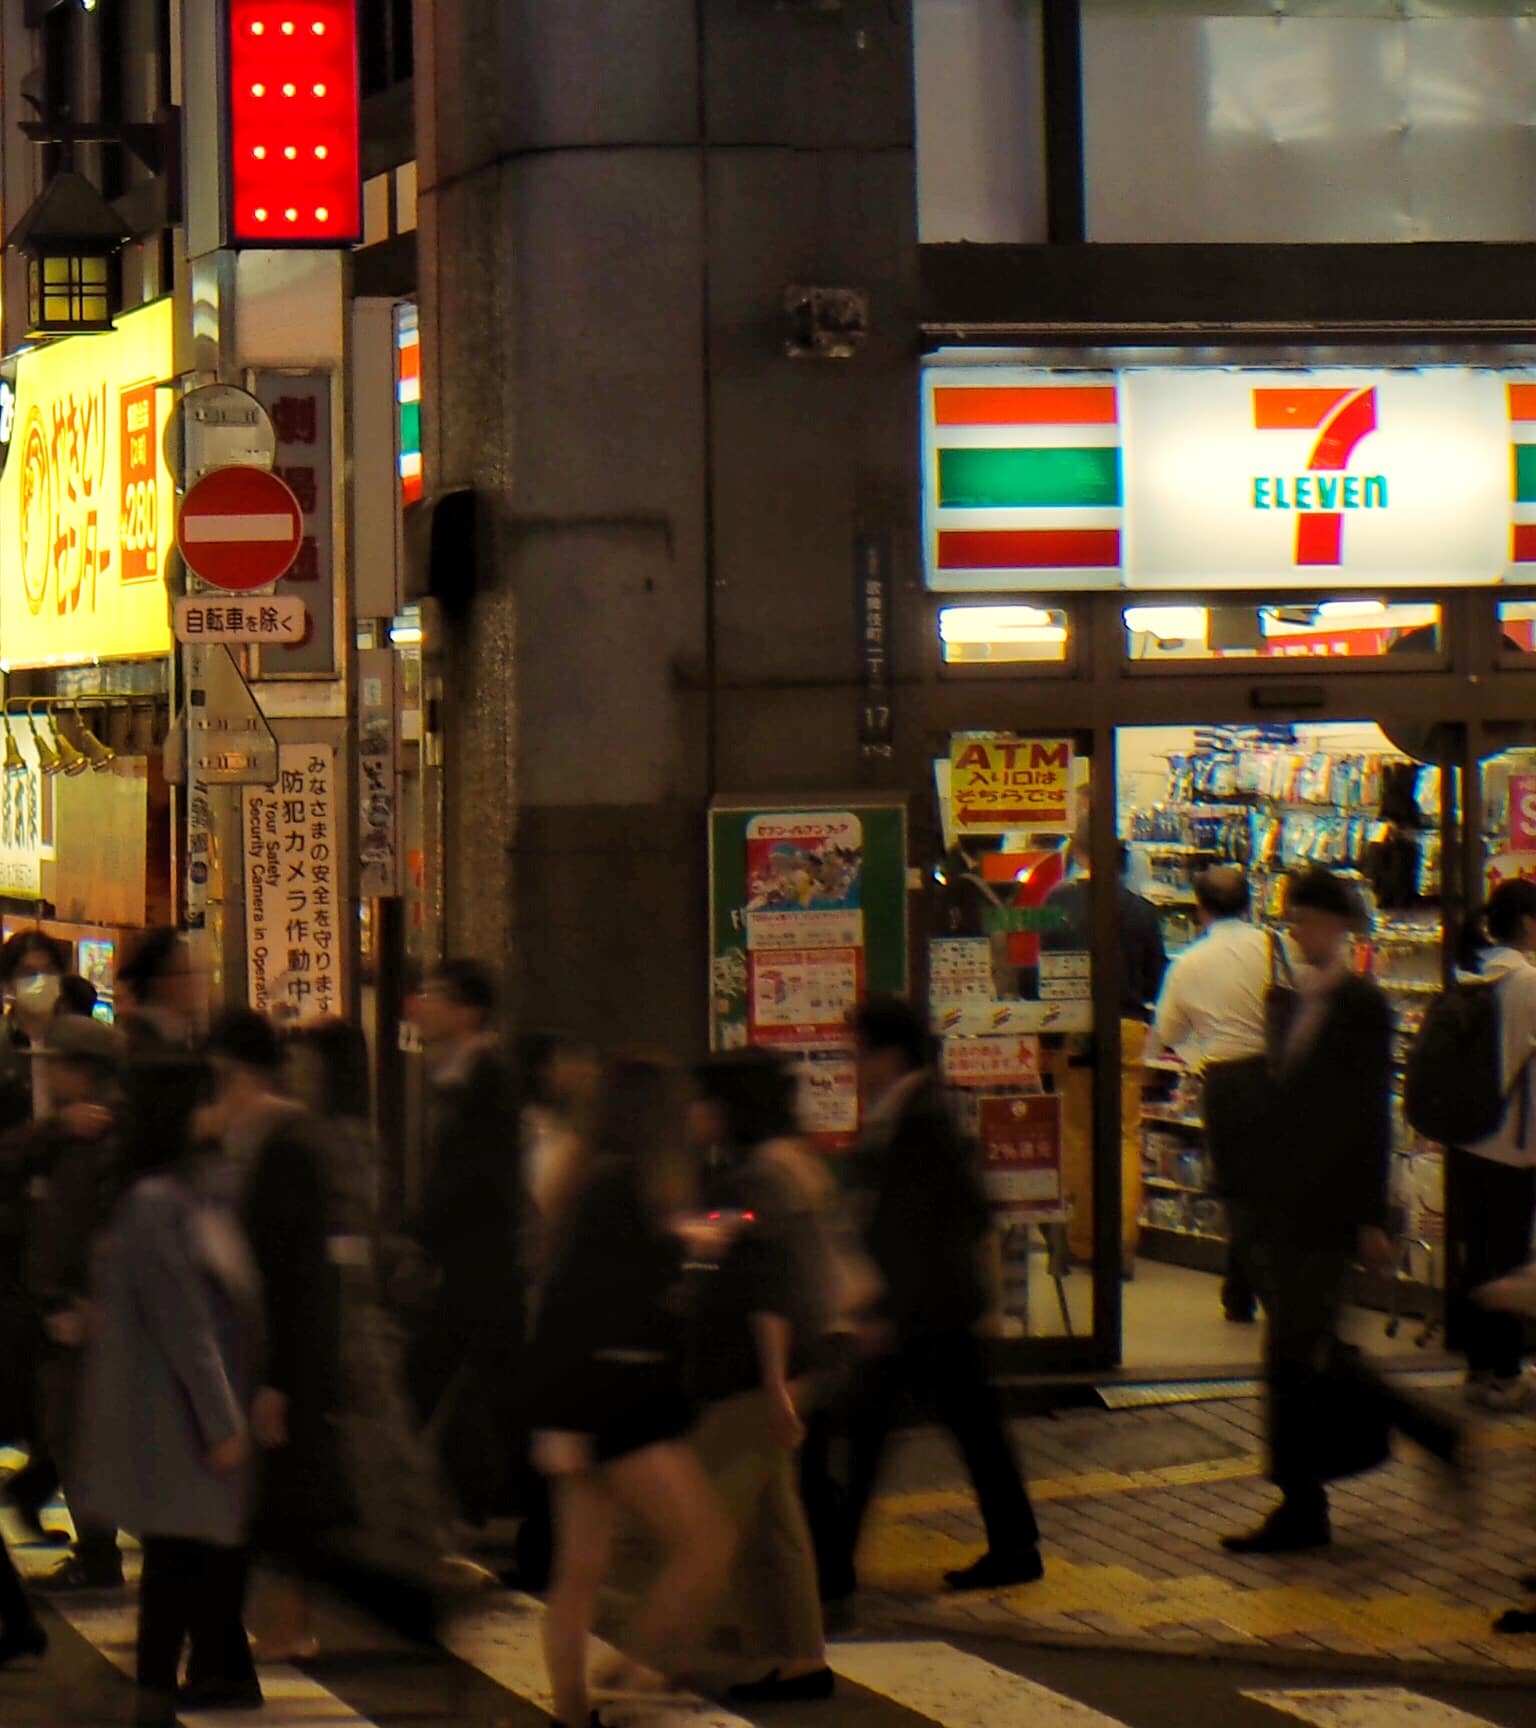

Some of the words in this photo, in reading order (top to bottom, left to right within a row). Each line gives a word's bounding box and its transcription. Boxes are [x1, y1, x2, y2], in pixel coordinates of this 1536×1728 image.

[52, 381, 106, 502] やきとり
[1253, 386, 1377, 565] 7
[54, 511, 110, 616] センター
[186, 607, 293, 634] 自転車を除く
[866, 706, 889, 728] 17
[955, 743, 1069, 769] ATM
[968, 771, 1057, 786] 入り口は
[266, 801, 279, 835] Your
[955, 789, 1066, 803] そちらです
[249, 797, 264, 859] Security
[265, 840, 280, 888] Safety
[281, 770, 311, 1002] 防犯カメラ作動中
[252, 864, 266, 922] Camera
[254, 927, 267, 941] in
[253, 946, 269, 1010] Operatio
